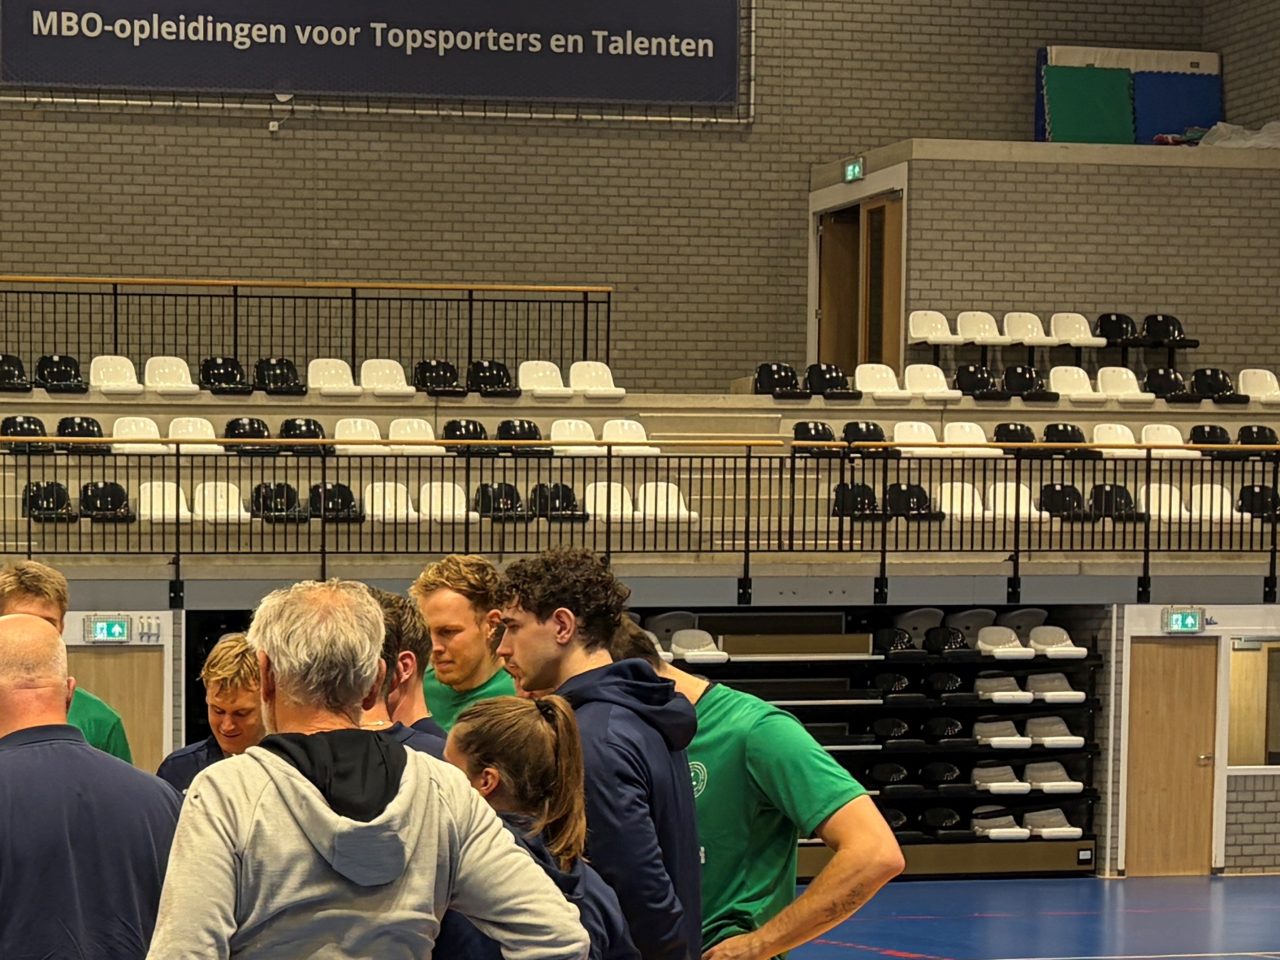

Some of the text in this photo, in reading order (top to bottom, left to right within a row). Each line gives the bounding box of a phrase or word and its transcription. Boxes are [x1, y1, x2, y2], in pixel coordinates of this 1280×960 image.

[32, 10, 714, 57] MBO-opleidingen voor Topsporters en Talenten
